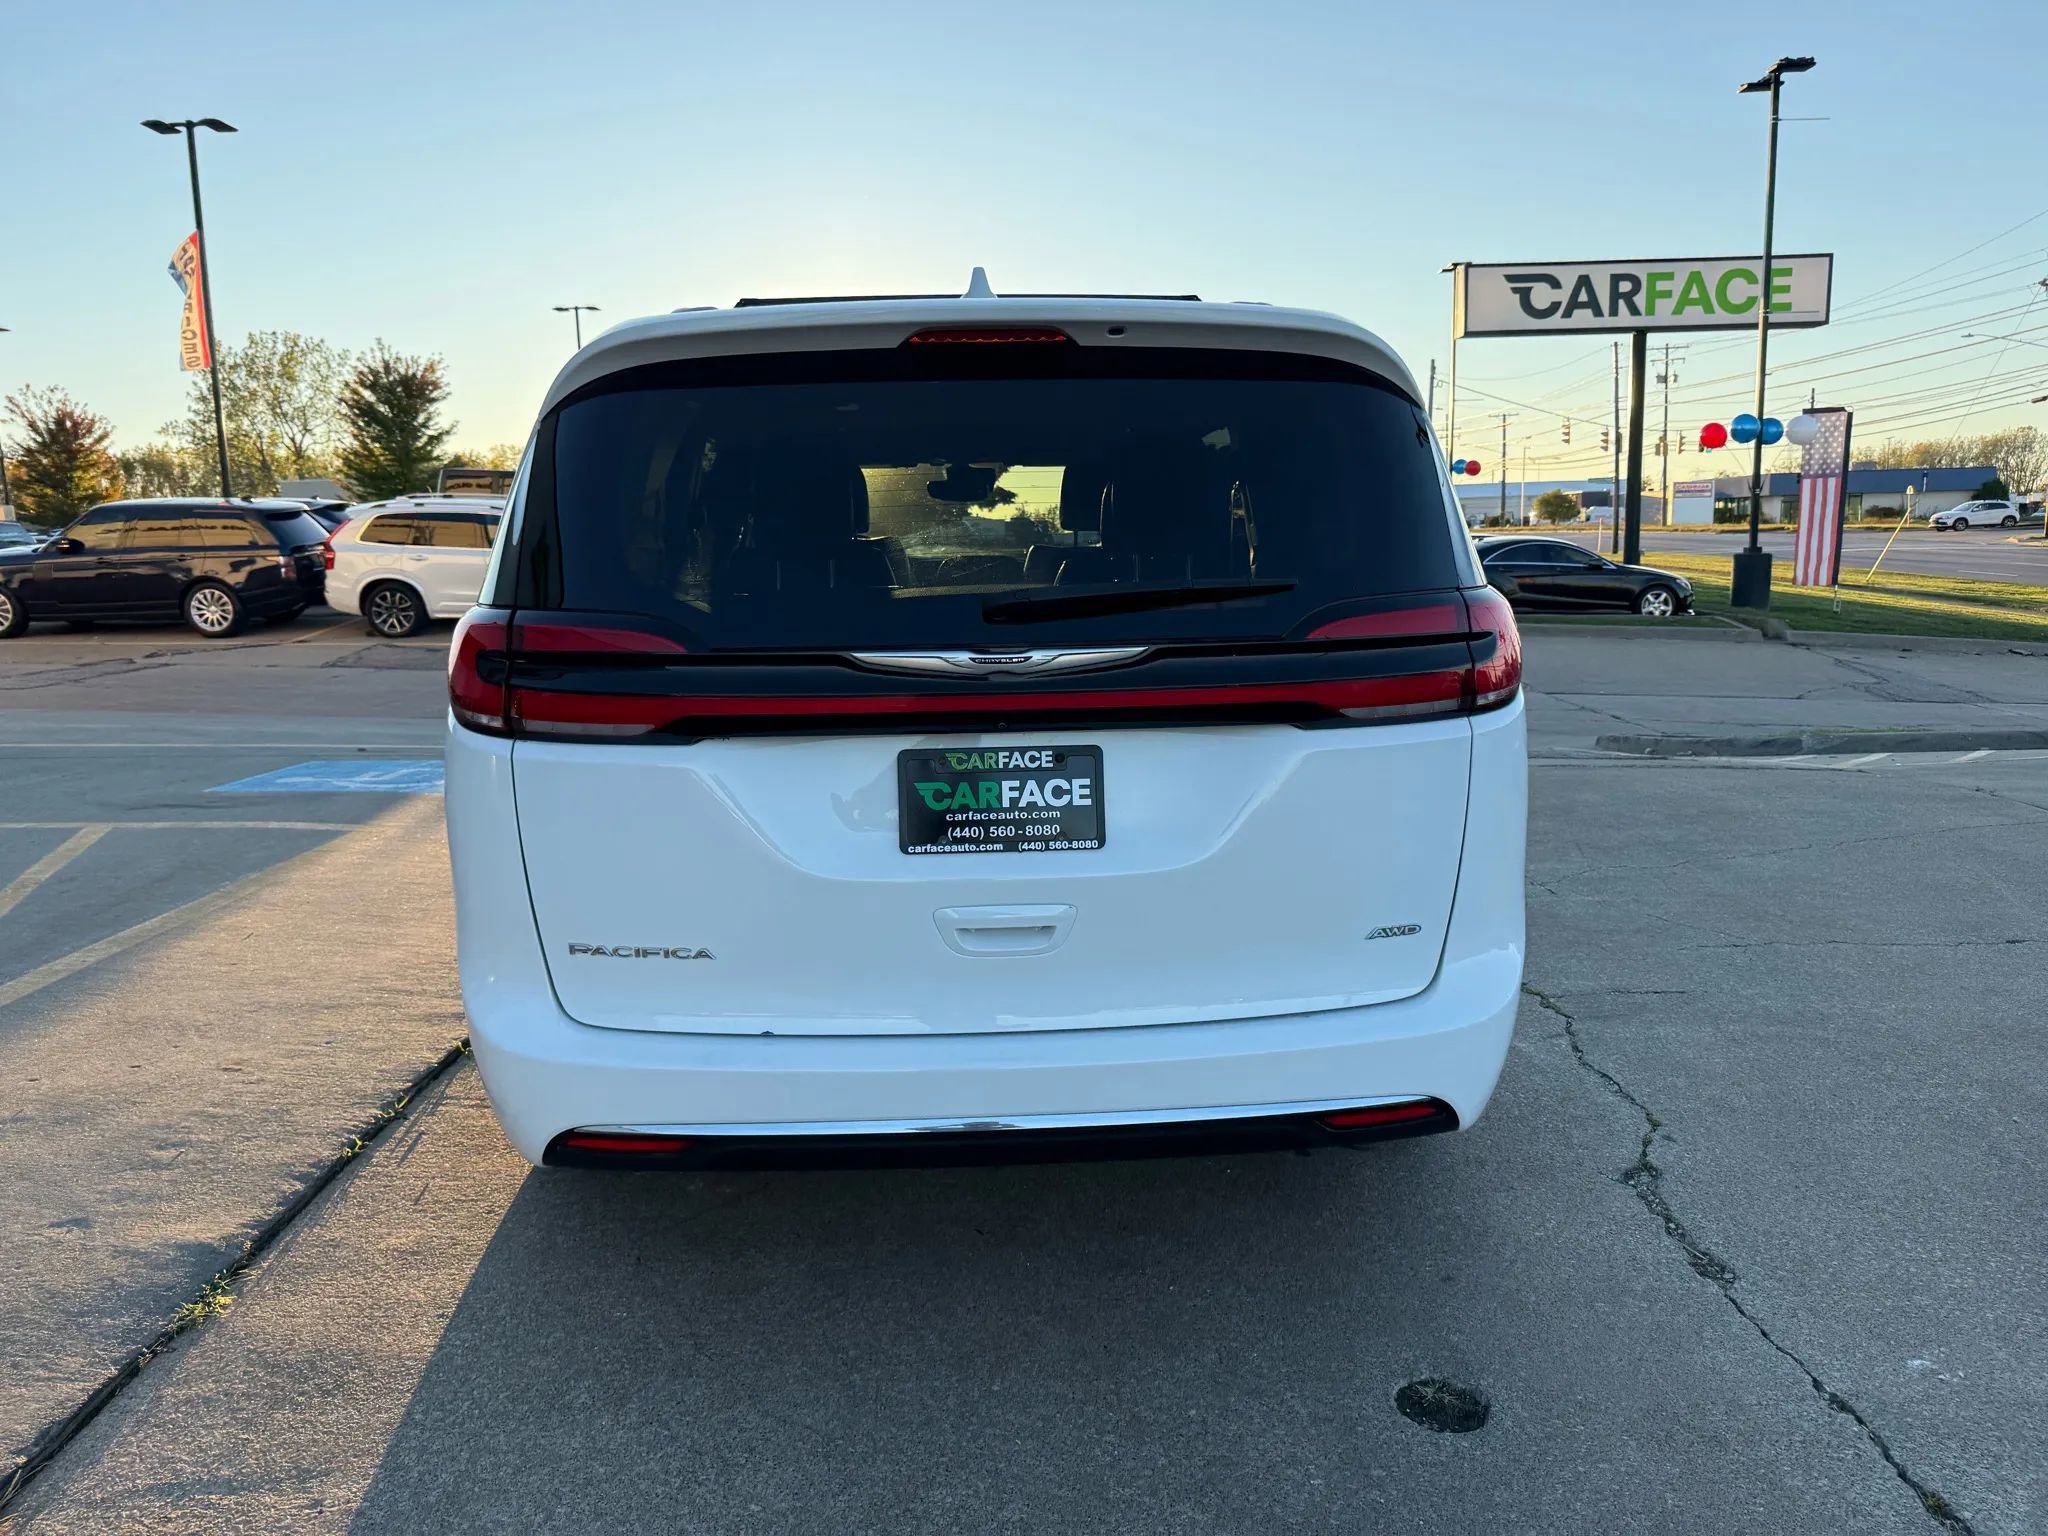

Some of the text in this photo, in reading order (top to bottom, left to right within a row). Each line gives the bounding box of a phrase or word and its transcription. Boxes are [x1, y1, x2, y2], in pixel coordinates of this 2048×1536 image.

[1503, 267, 1793, 320] CARFACE
[944, 750, 1053, 770] CARFACE
[913, 778, 1092, 811] CARFACE
[946, 810, 1061, 822] carfaceauto.com
[947, 826, 984, 842] (440)
[907, 840, 1099, 854] carfaceauto.com (440) 560-8080
[1364, 924, 1422, 940] AWD
[567, 942, 718, 960] PACIFICA
